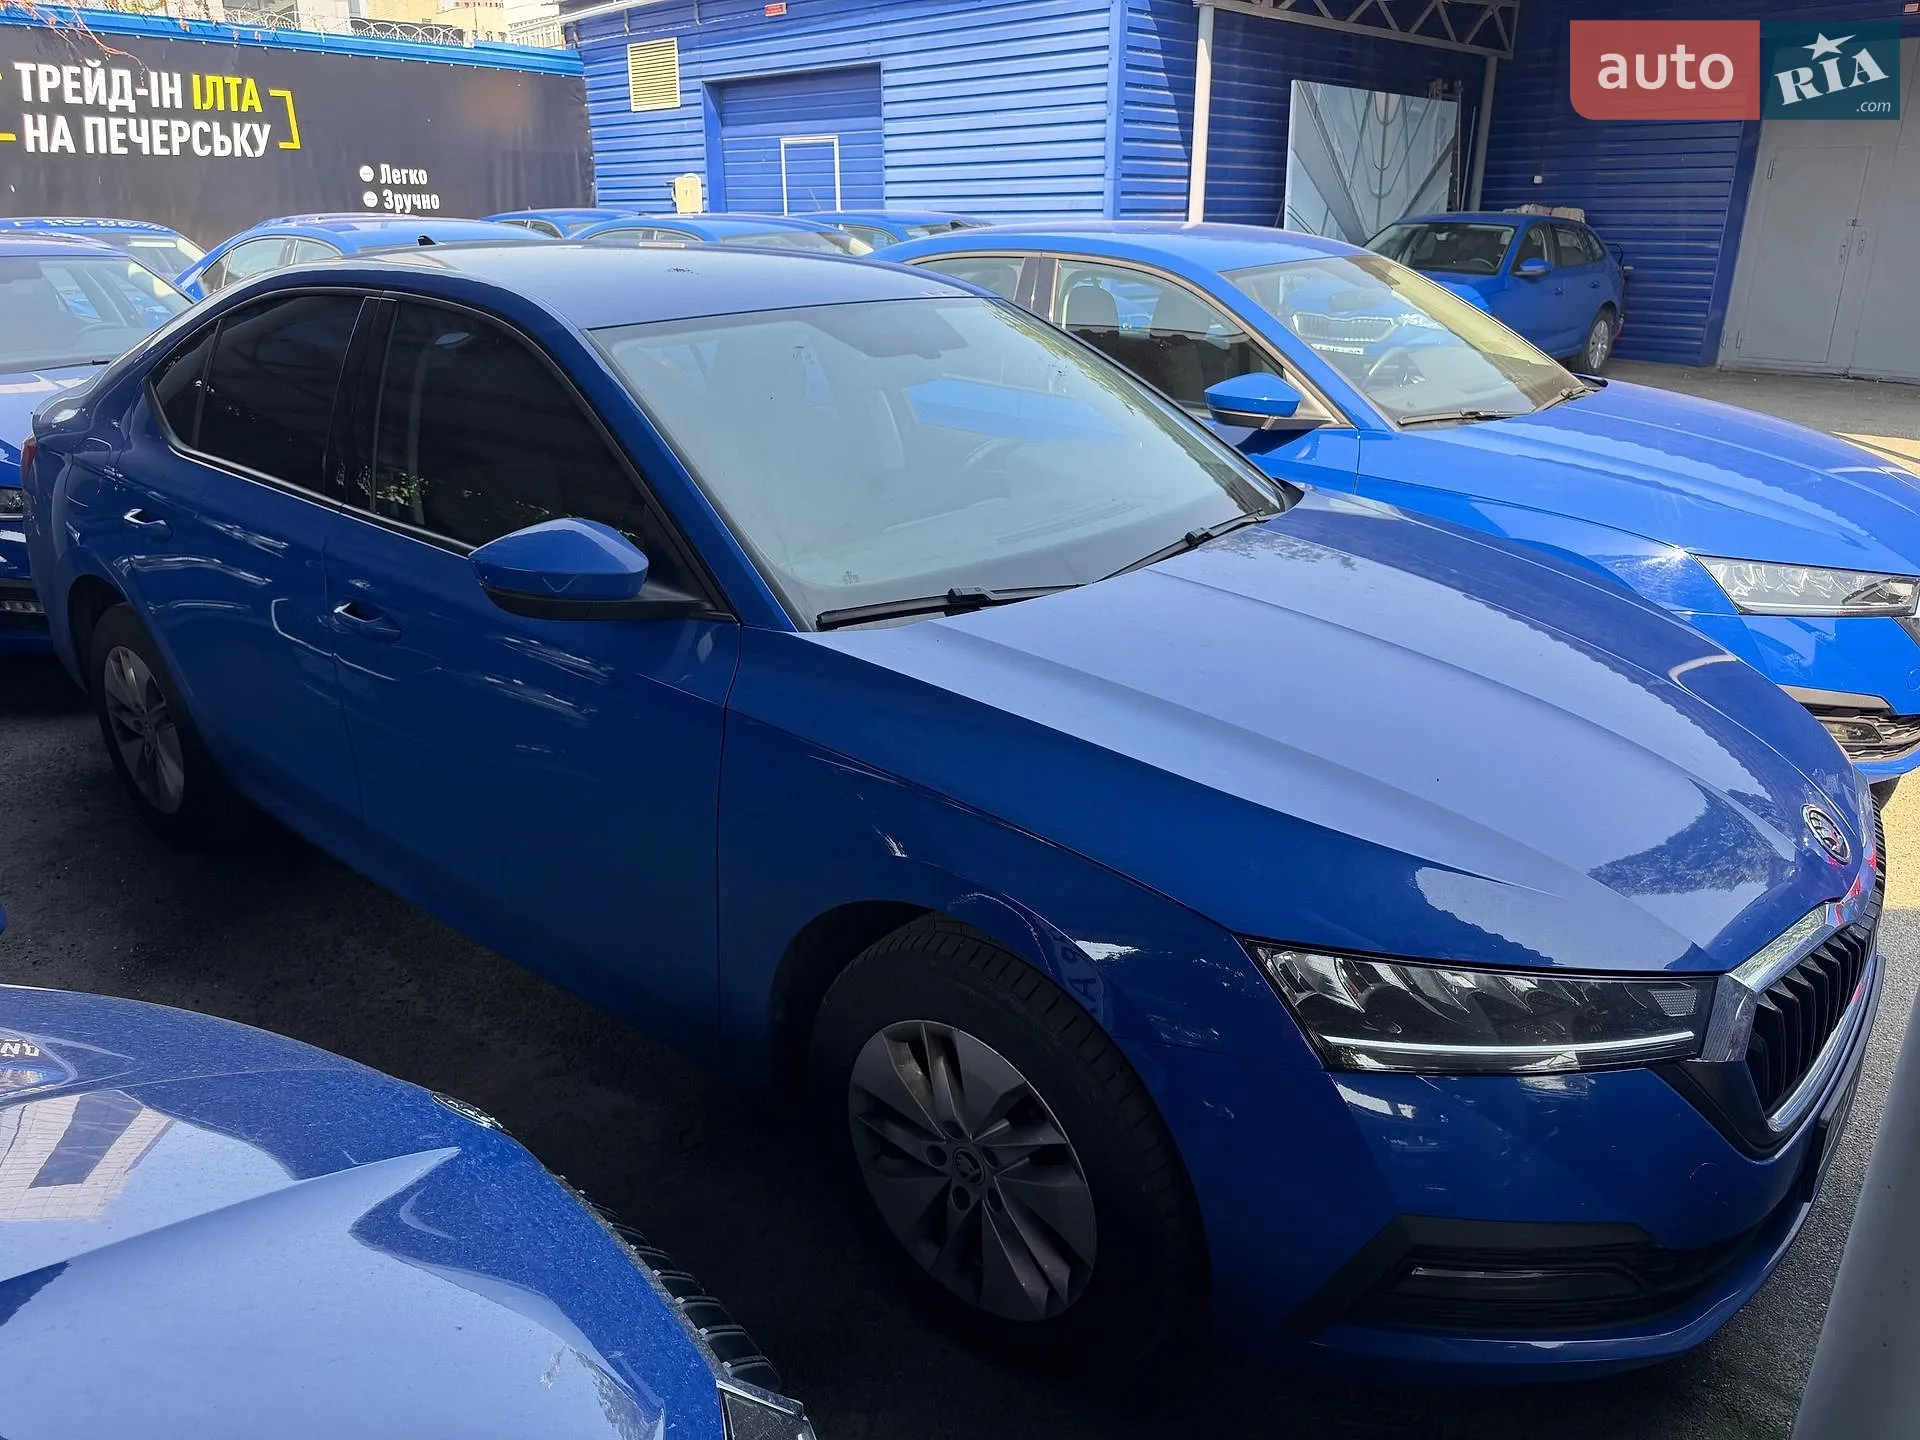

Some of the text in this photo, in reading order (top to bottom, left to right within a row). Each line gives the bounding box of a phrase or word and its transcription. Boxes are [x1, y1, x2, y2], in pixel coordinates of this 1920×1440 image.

[13, 58, 263, 113] ТРЕЙД-ІН ІЛТА
[22, 113, 272, 158] НА ПЕЧЕРСЬКУ
[380, 163, 428, 185] Легко
[382, 189, 440, 214] Зручно
